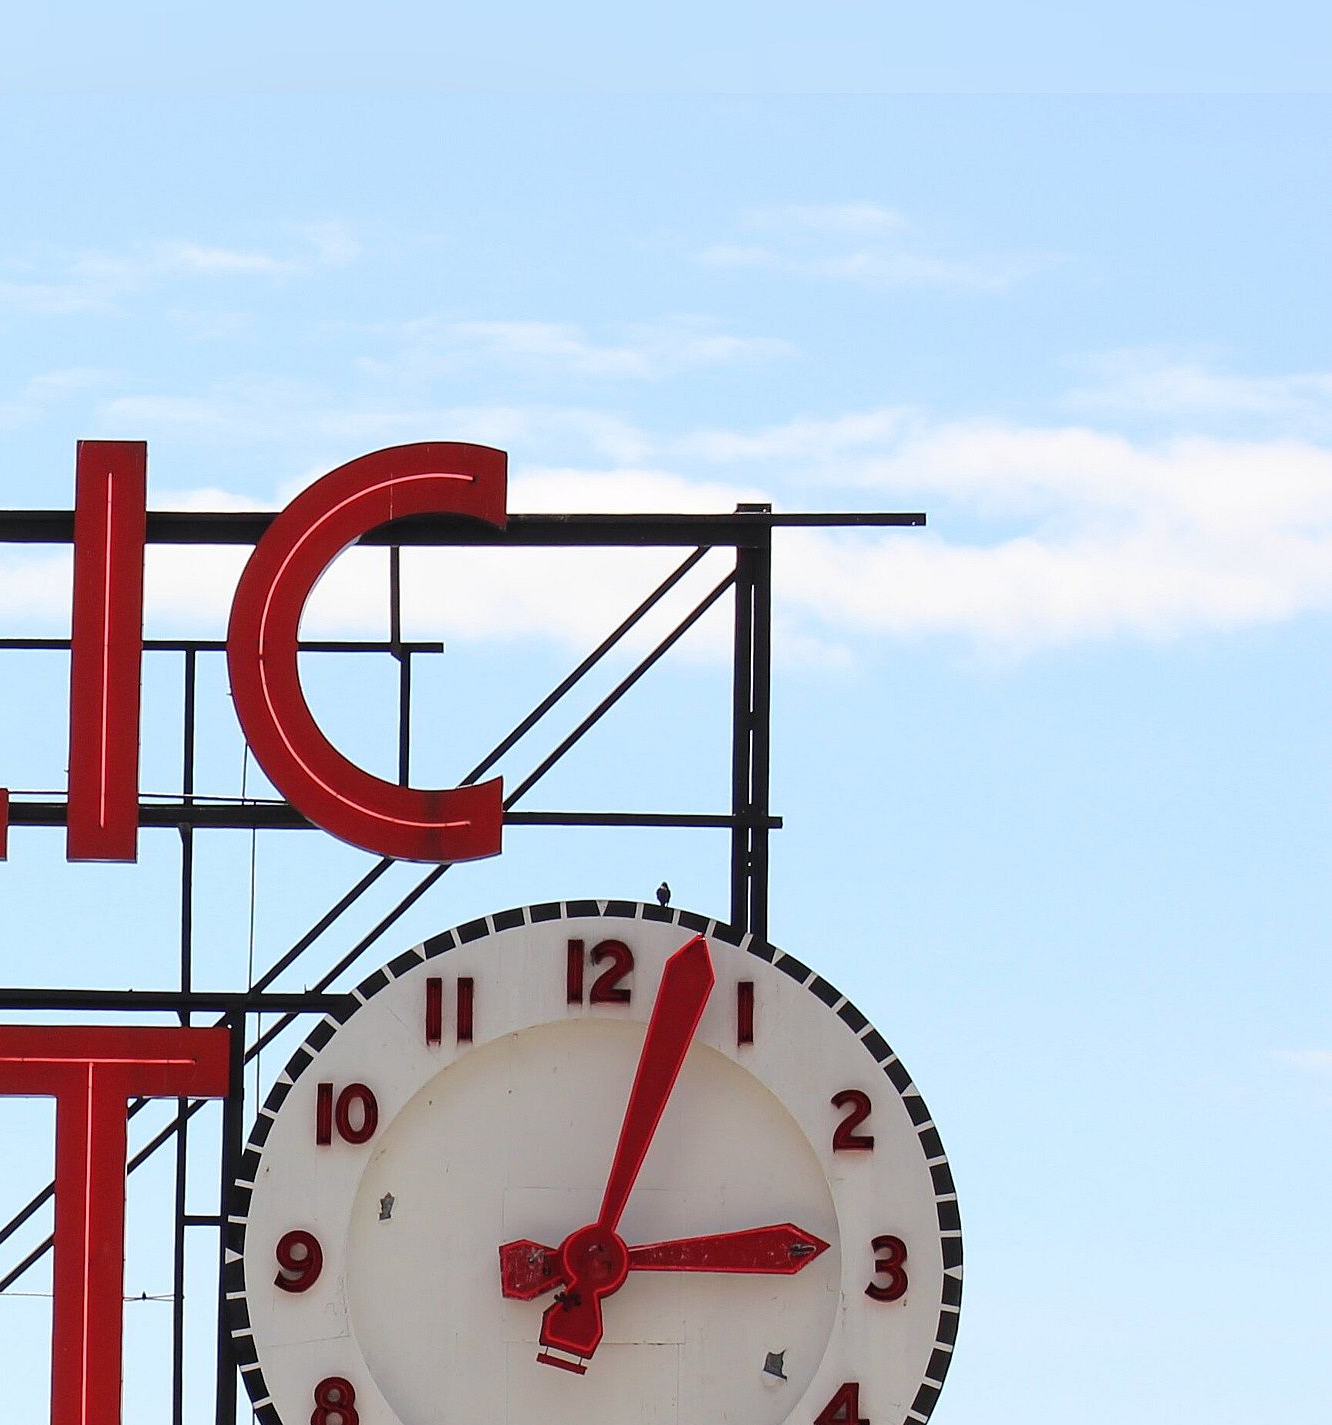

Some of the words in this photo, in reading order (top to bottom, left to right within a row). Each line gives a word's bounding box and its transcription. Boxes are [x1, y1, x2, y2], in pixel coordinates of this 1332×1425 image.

[566, 939, 635, 1005] 12
[425, 977, 474, 1043] 11
[737, 981, 754, 1045] 1
[316, 1082, 378, 1146] 10
[831, 1089, 875, 1152] 2
[274, 1230, 323, 1293] 9
[865, 1235, 909, 1302] 3
